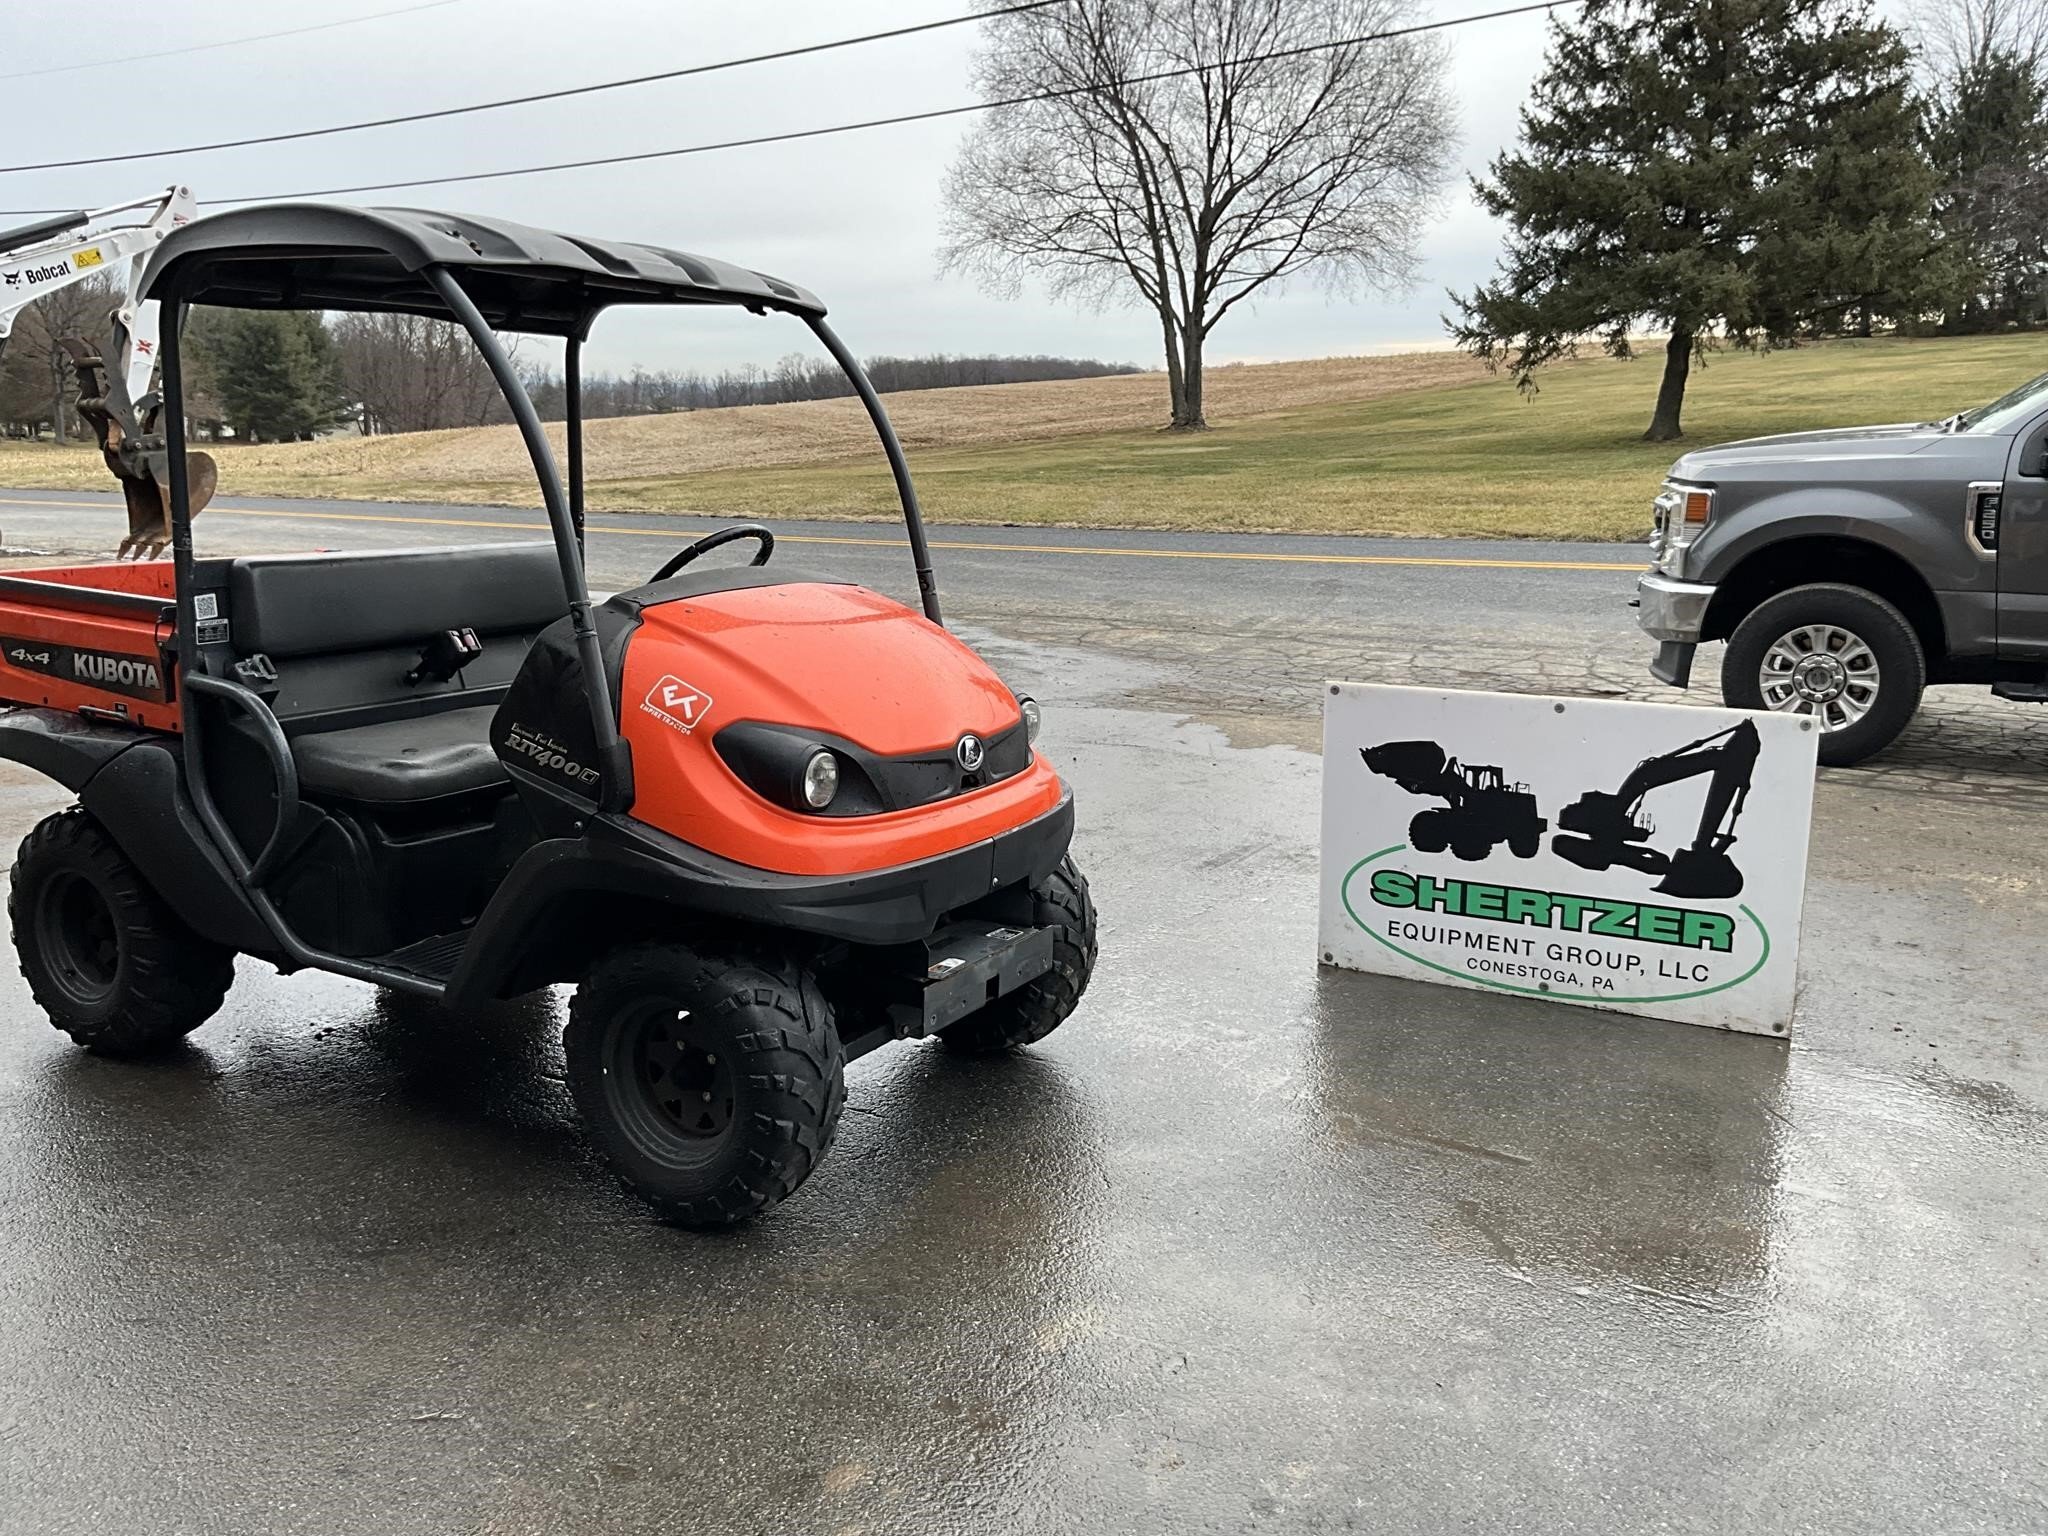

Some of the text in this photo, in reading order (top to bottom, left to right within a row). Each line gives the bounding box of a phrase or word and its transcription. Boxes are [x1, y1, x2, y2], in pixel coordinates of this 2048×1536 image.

[25, 260, 71, 284] Bobcat
[11, 648, 161, 689] 4x4 KUBOTA
[639, 703, 691, 735] EMPIRE TRACTOR
[662, 684, 698, 719] ET
[1370, 869, 1735, 953] SHERTZER
[1388, 920, 1709, 982] EQUIPMENT GROUP, LLC
[1466, 957, 1614, 991] CONESTOGA, PA
